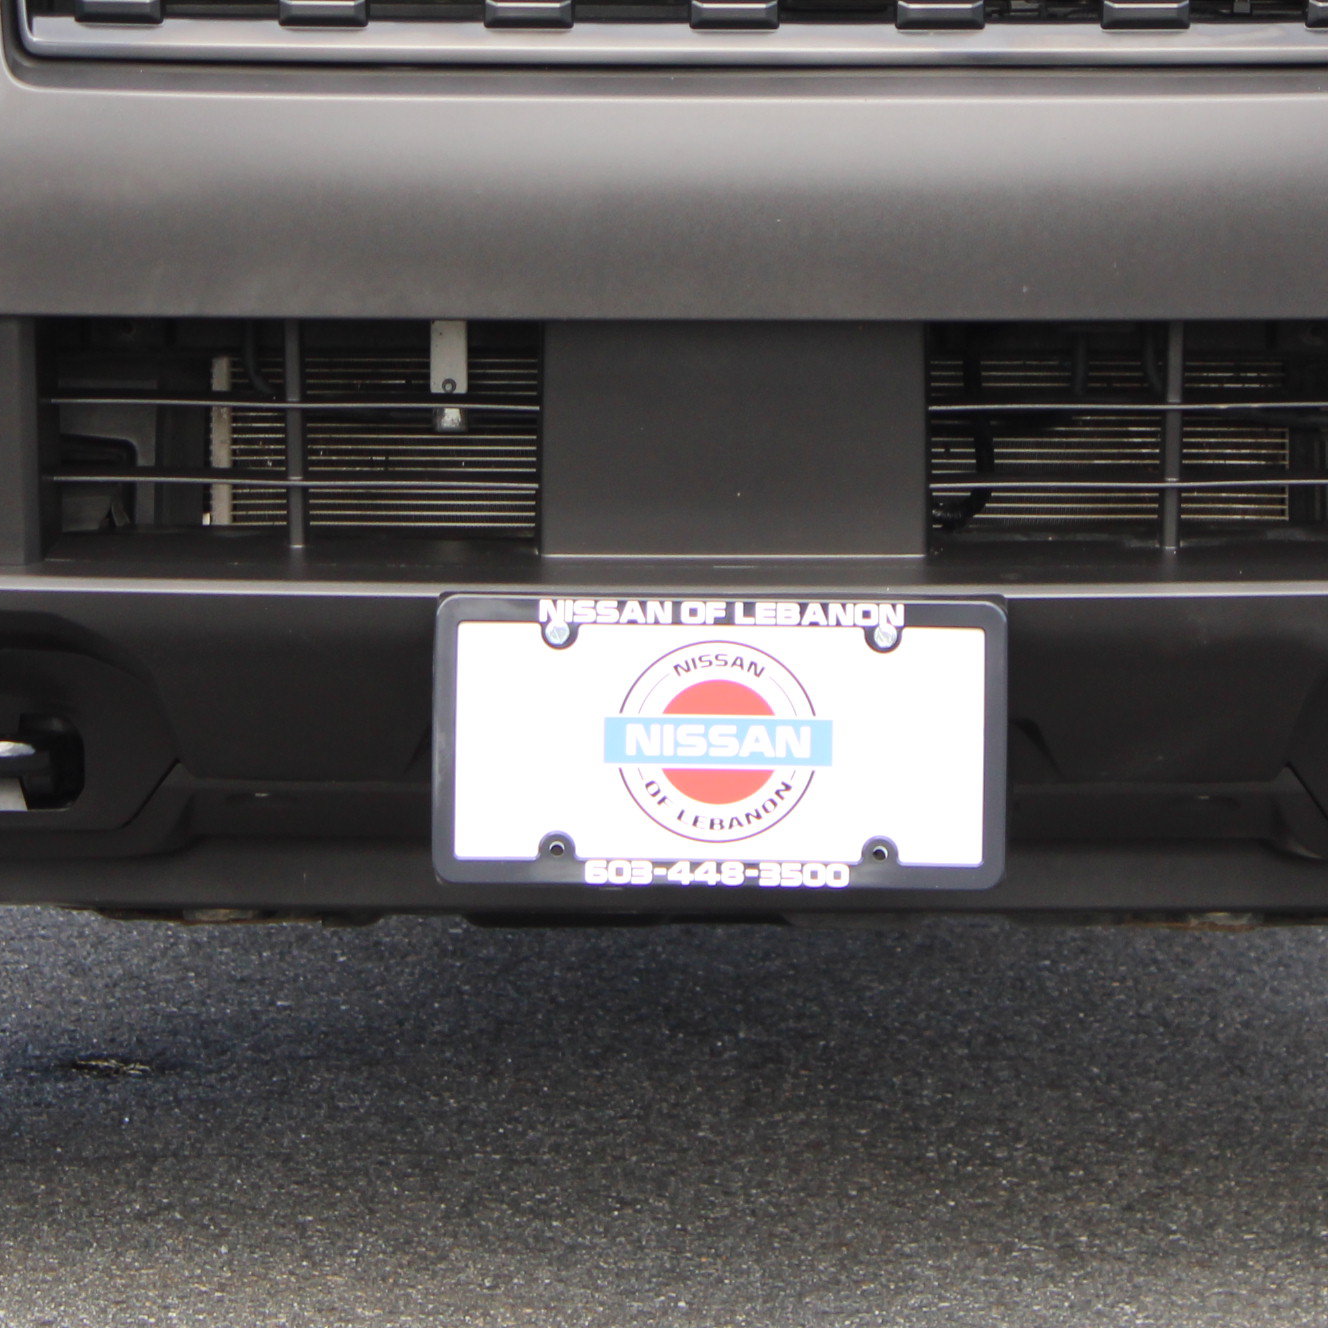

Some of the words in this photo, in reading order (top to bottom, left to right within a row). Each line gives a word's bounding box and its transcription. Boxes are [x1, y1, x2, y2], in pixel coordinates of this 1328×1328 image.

[539, 599, 672, 624] NISSAN
[680, 601, 727, 625] OF
[734, 602, 905, 627] LEBANON
[673, 653, 765, 678] NISSAN
[625, 723, 811, 759] NISSAN
[645, 780, 673, 806] OF
[677, 781, 793, 831] LEBANON
[585, 859, 850, 888] 603-448-3500
